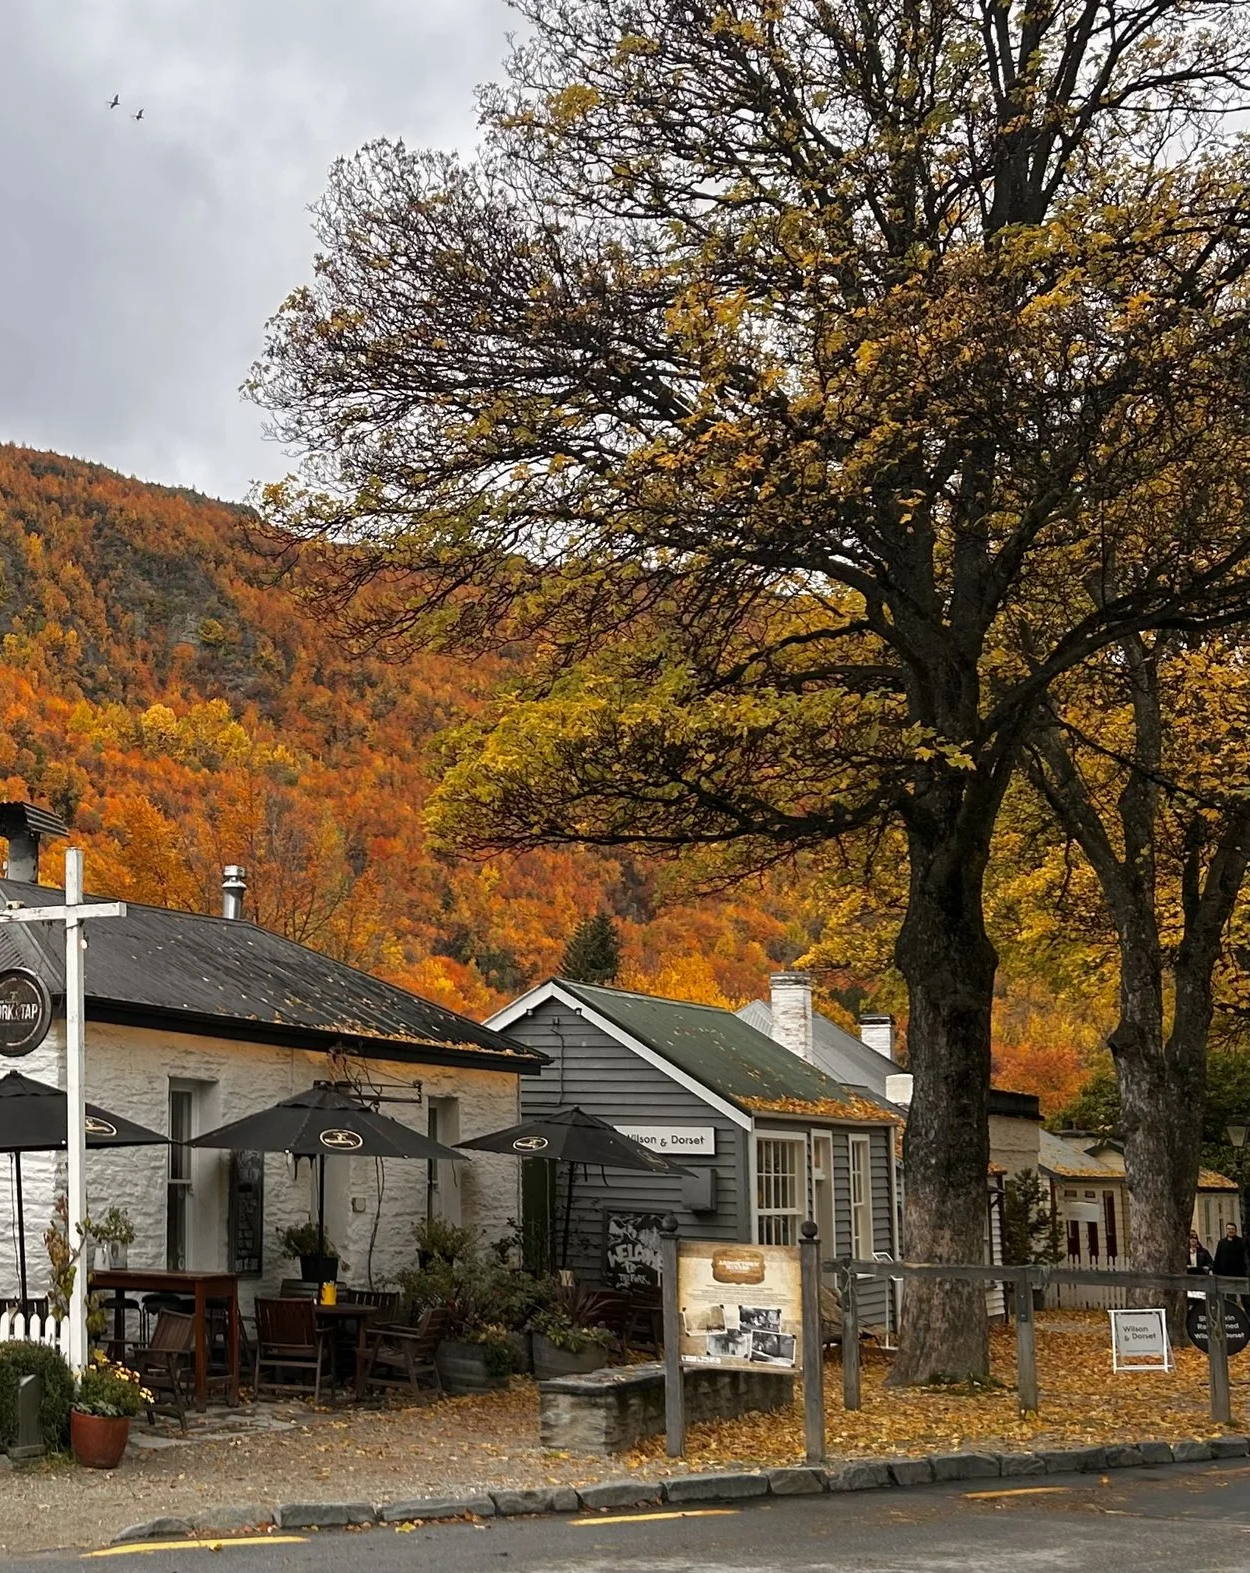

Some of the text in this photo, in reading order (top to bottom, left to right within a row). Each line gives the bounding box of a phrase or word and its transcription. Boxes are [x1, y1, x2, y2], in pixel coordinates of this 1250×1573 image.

[20, 1003, 38, 1019] TAP
[660, 1138, 667, 1147] &
[671, 1135, 705, 1144] Dorset
[1123, 1325, 1149, 1333] Wilson
